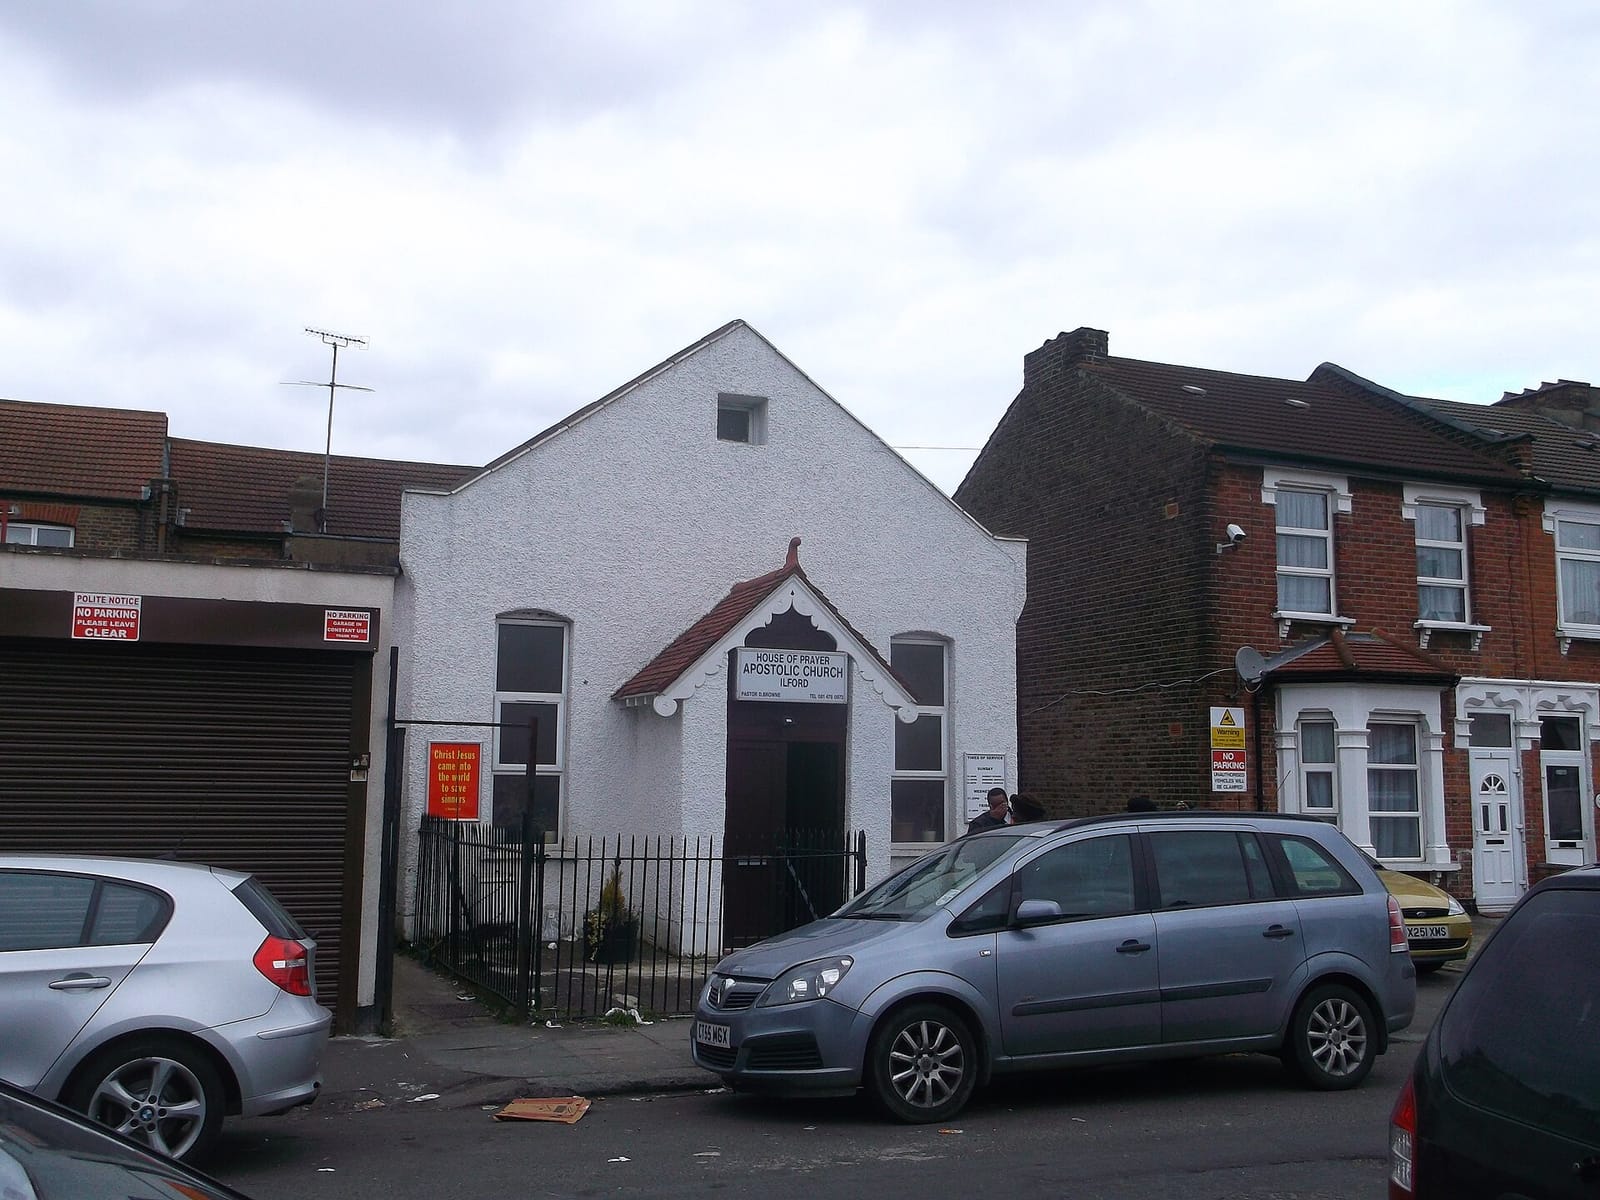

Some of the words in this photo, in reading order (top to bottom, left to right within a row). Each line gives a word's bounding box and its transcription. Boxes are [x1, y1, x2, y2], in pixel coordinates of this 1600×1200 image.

[77, 594, 107, 604] POLITE
[109, 596, 140, 606] NOTICE
[77, 607, 92, 617] NO
[94, 608, 137, 619] PARKING
[338, 612, 369, 620] PARKING
[77, 619, 108, 627] PLEASE
[84, 628, 127, 638] CLEAR
[756, 653, 785, 663] HOUSE
[786, 654, 798, 664] OF
[800, 655, 830, 665] PRAYER
[743, 663, 800, 676] APOSTOLIC
[803, 665, 843, 678] CHURCH
[780, 678, 809, 688] ILFORD
[434, 749, 455, 760] Christ
[457, 750, 476, 760] Jesus
[1222, 752, 1235, 760] NO
[437, 763, 456, 771] came
[456, 762, 472, 771] nto
[1213, 761, 1245, 770] PARKING
[438, 772, 450, 782] the
[441, 784, 449, 793] to
[1407, 927, 1428, 938] X251
[1429, 926, 1447, 937] XMS
